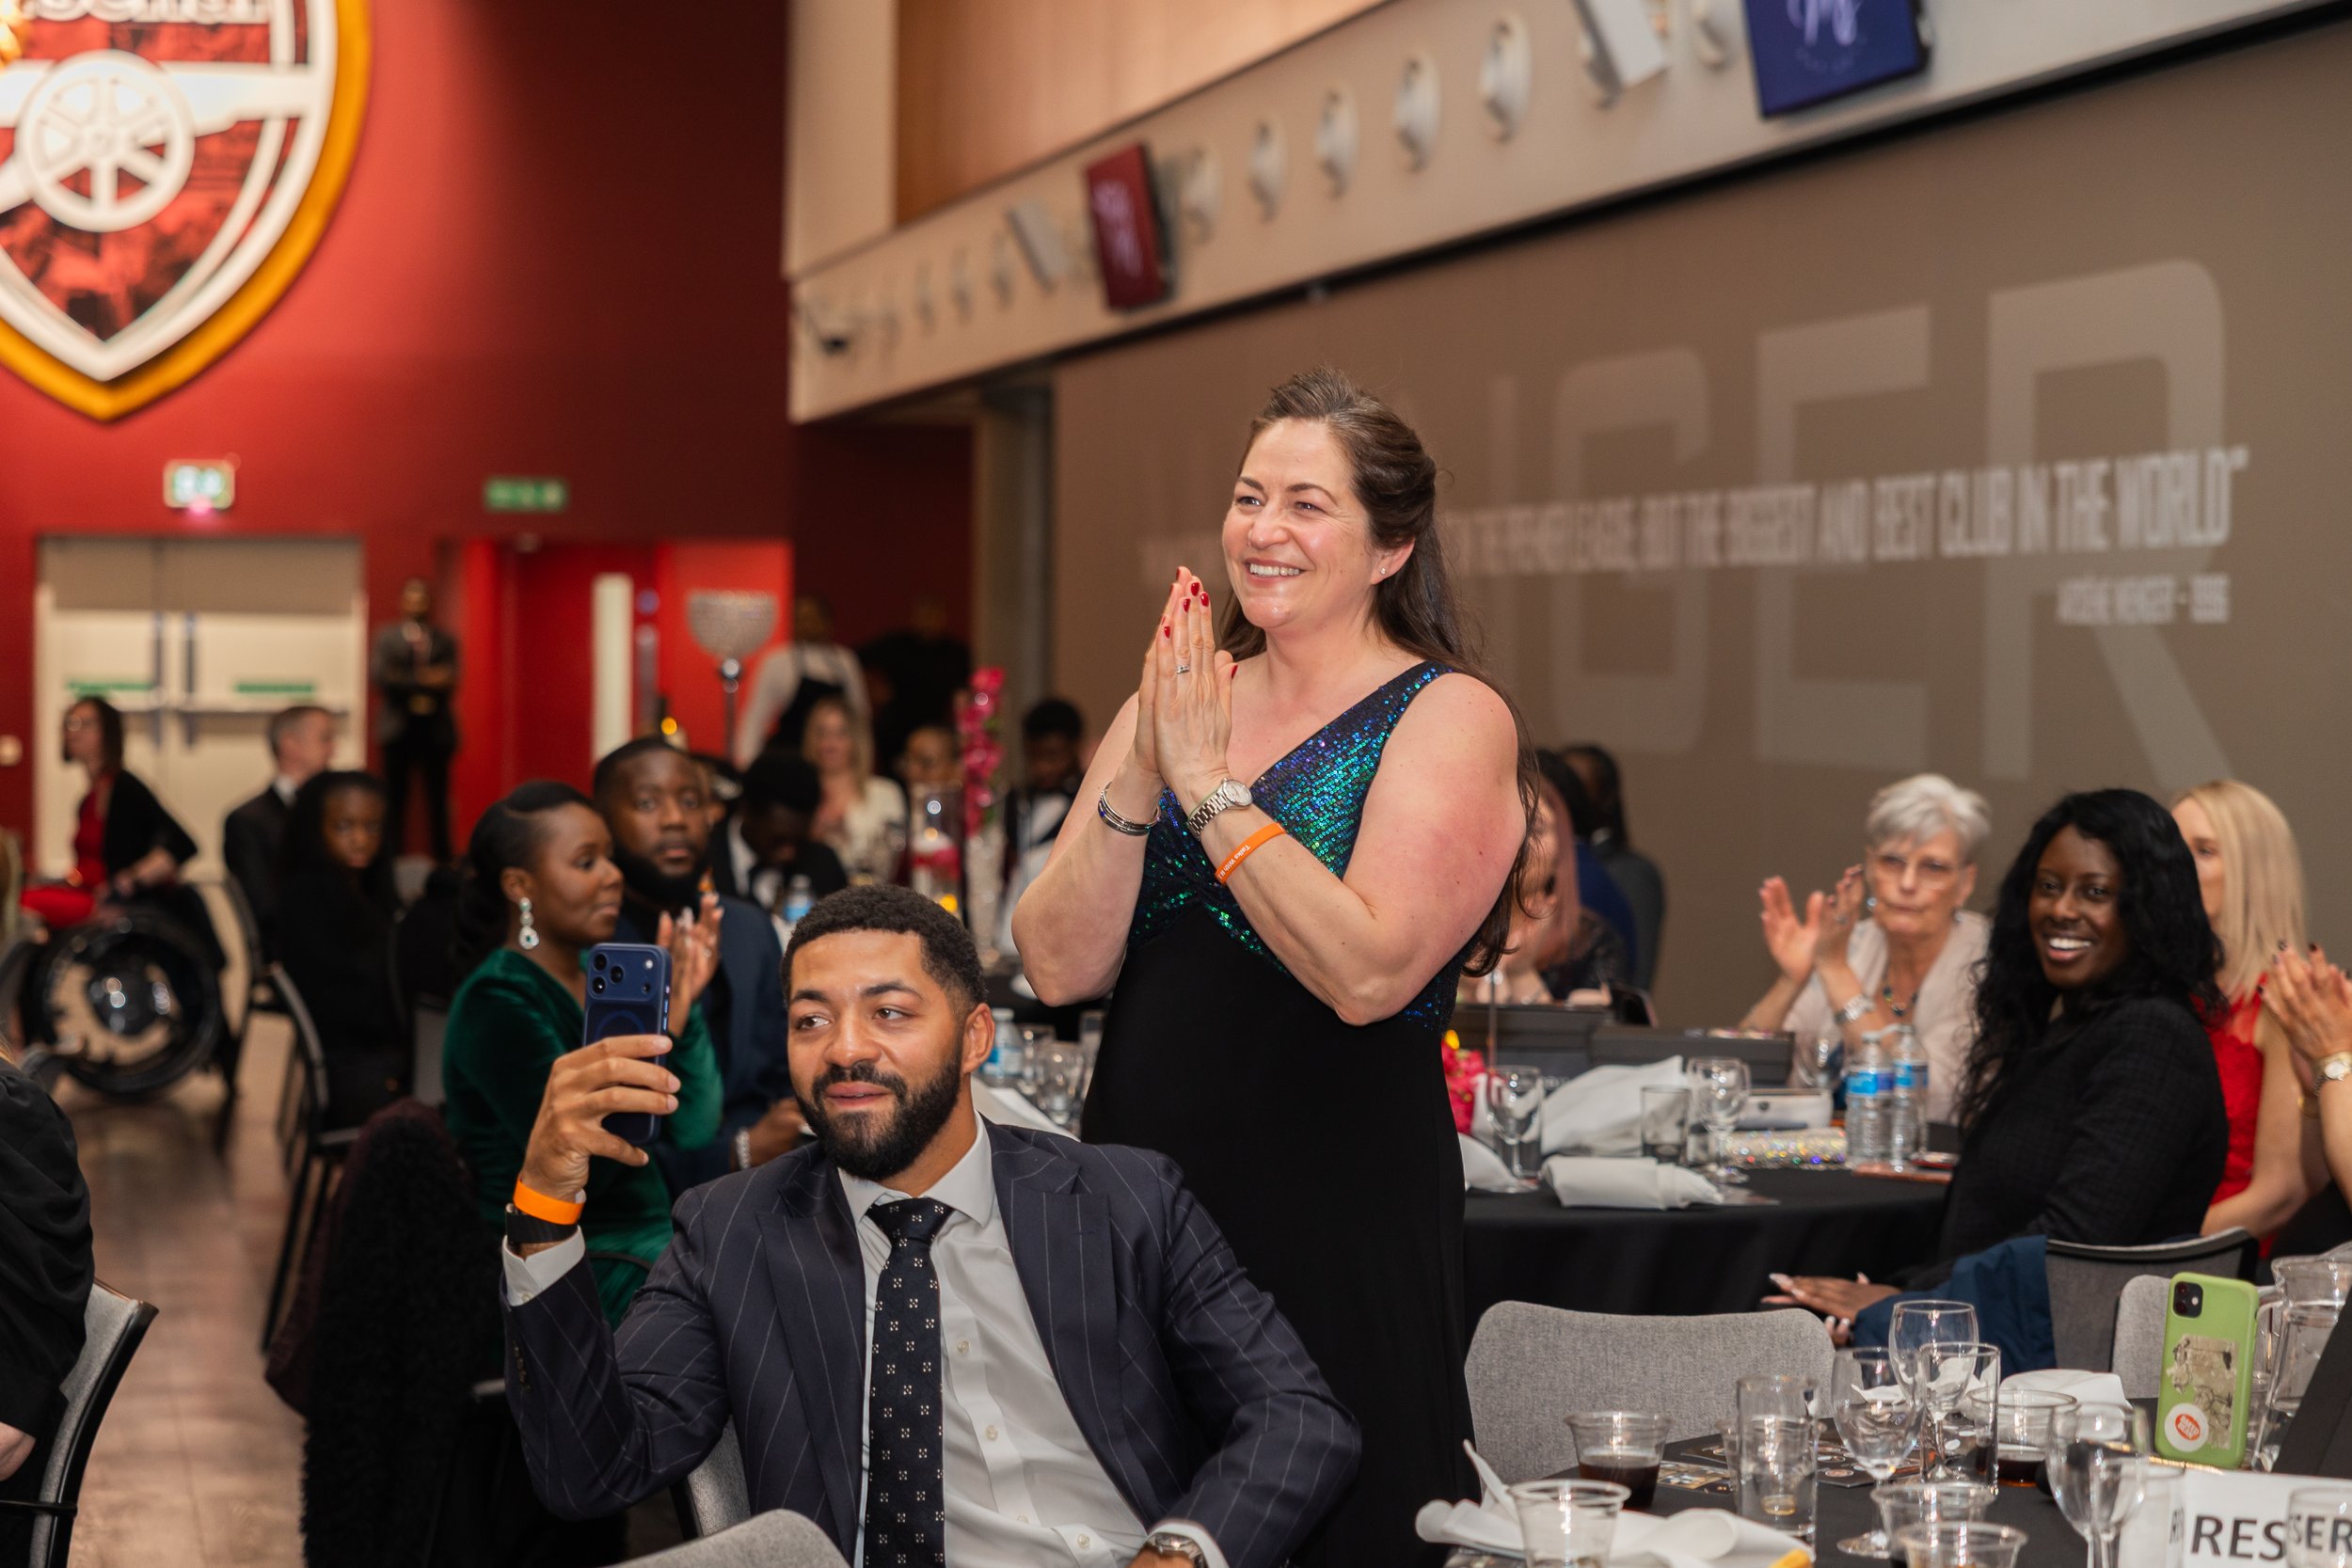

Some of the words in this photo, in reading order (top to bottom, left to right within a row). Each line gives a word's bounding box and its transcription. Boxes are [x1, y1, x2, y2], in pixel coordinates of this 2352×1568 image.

[1820, 478, 1868, 562] AND
[1874, 472, 1935, 561] BEST
[1941, 465, 2011, 558] CLUB
[2017, 462, 2049, 553] IN
[2055, 456, 2109, 552] THE
[1233, 844, 1250, 859] Talks
[1224, 858, 1236, 871] With
